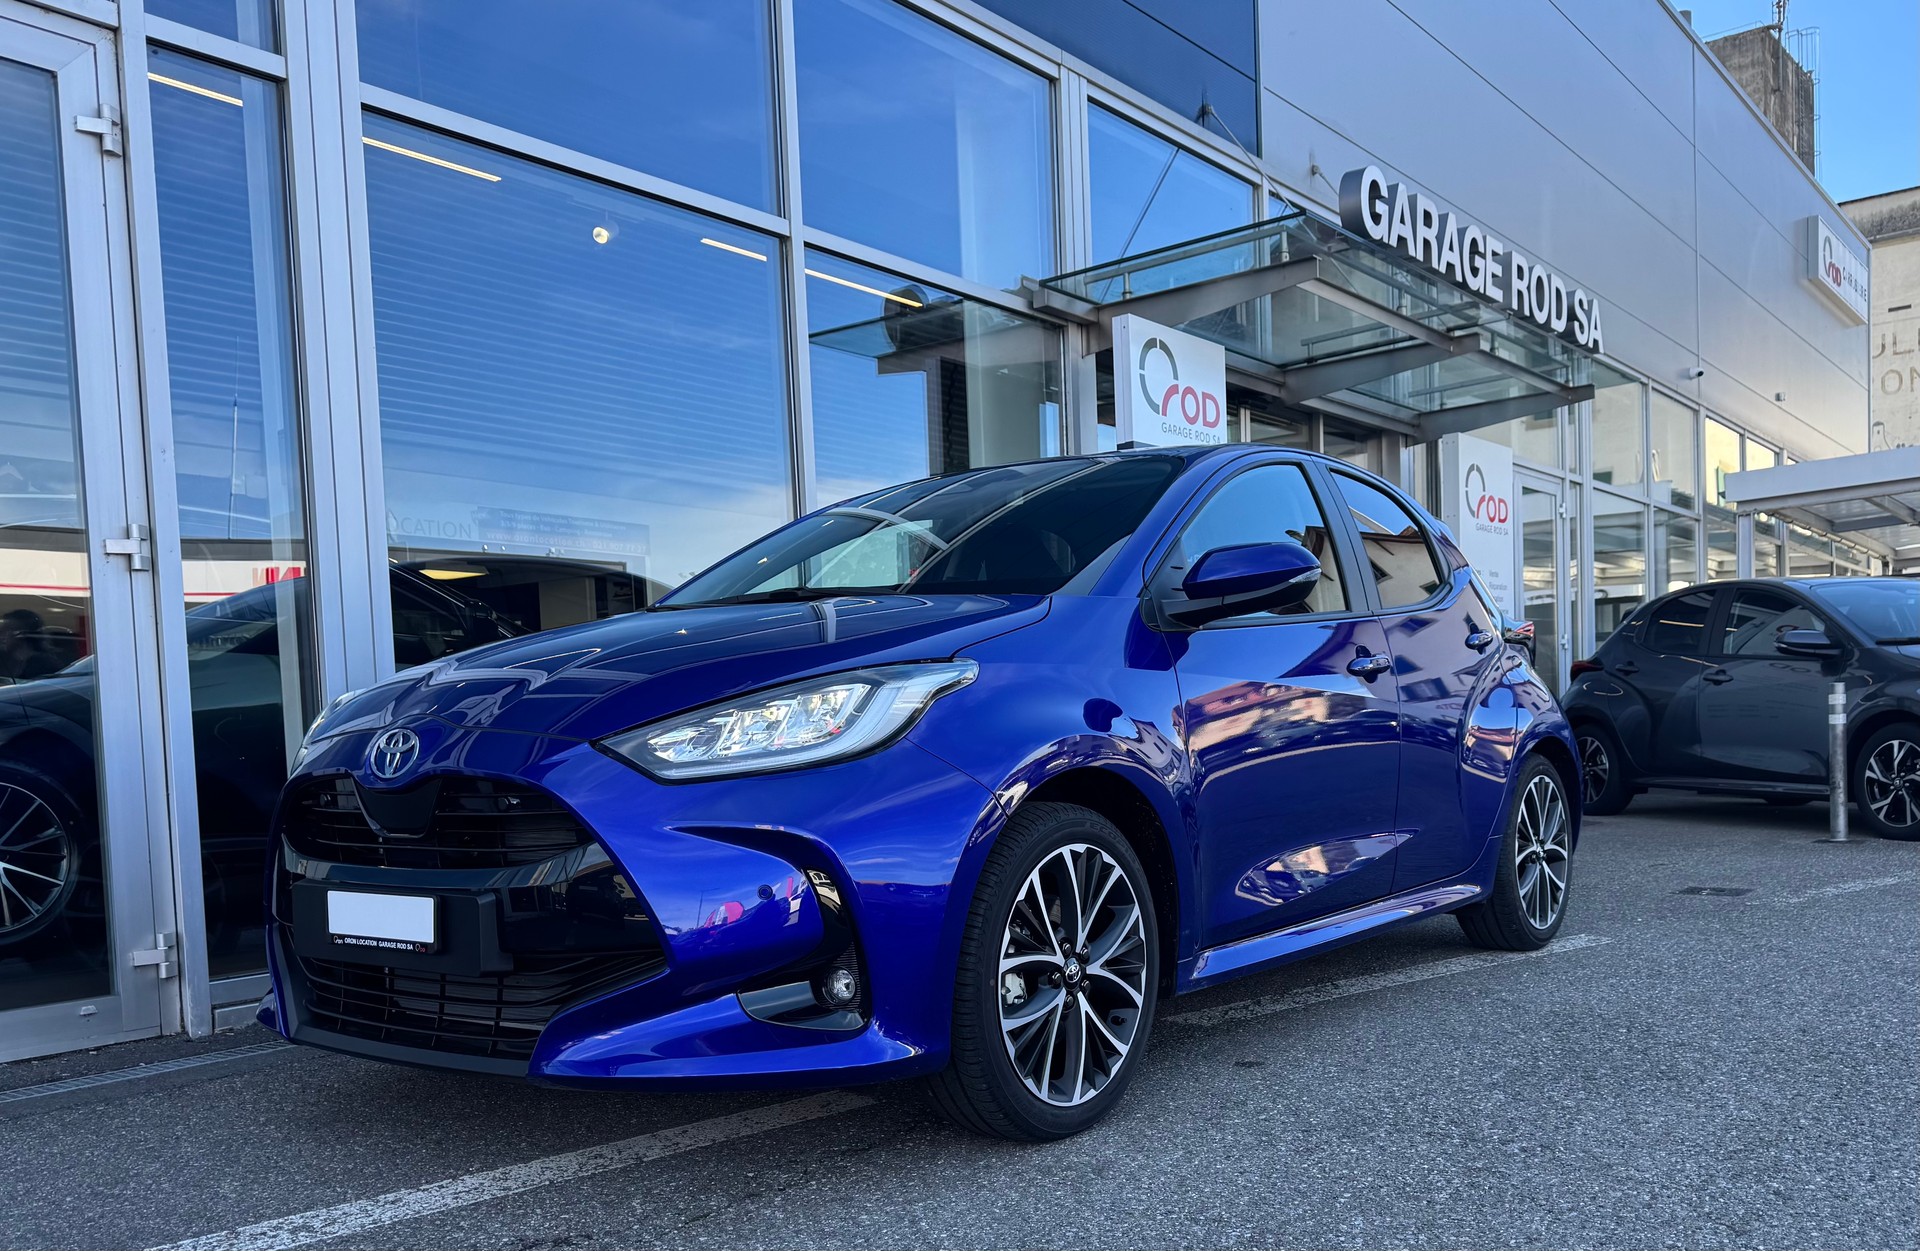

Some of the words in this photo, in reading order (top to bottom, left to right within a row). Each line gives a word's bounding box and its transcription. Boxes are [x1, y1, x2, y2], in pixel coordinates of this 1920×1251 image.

[1360, 164, 1504, 304] GARAGE
[1511, 250, 1568, 334] ROD
[1573, 287, 1605, 355] SA
[1161, 422, 1193, 440] GARAGE
[1194, 430, 1211, 444] ROD
[1475, 522, 1493, 534] GARAGE
[344, 937, 357, 945] ORON
[357, 938, 378, 947] LOCATION
[378, 940, 397, 949] GARAGE
[397, 942, 407, 950] ROD
[407, 943, 414, 951] SA
